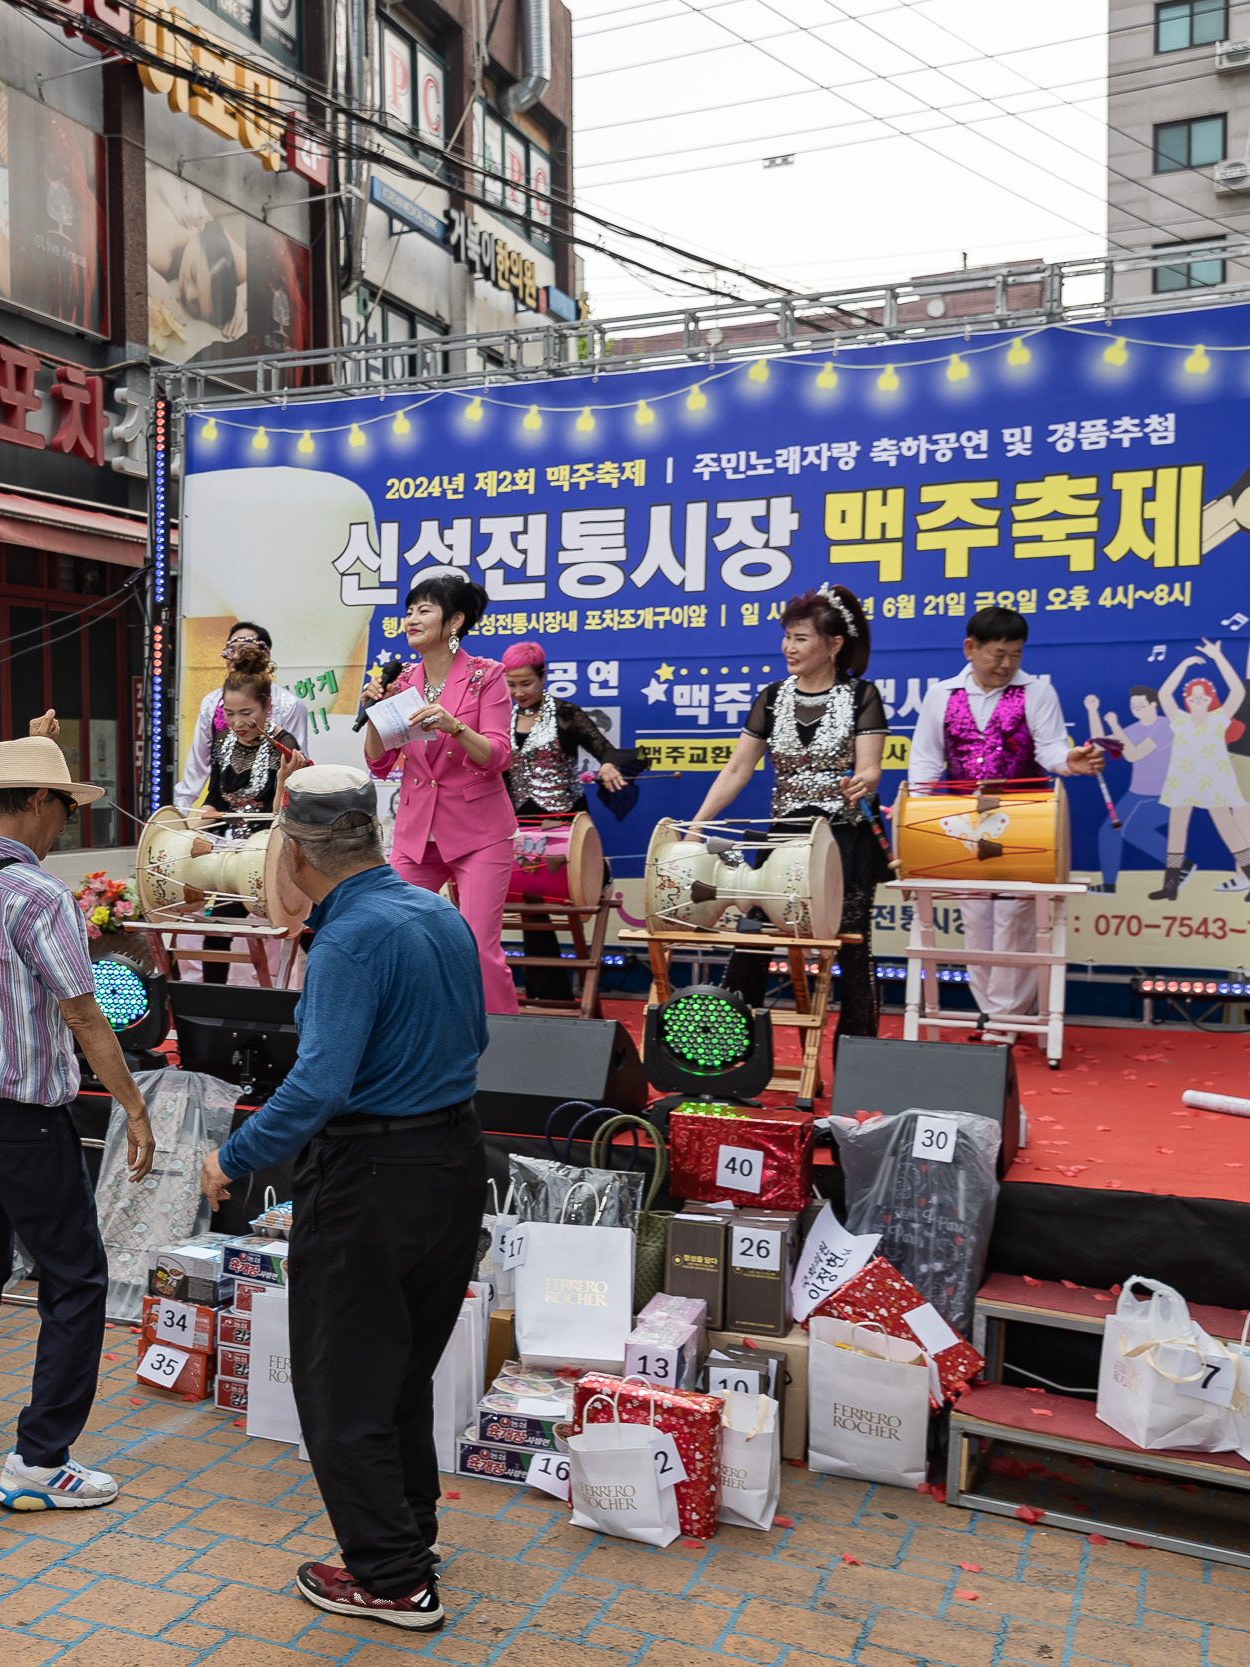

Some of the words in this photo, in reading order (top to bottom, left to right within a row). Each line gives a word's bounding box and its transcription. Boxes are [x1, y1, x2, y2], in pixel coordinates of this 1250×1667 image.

[450, 208, 538, 309] 거북이한의원
[692, 440, 861, 482] 주민노래자랑
[869, 429, 990, 467] 축하공연
[1001, 425, 1033, 458] 및
[1046, 413, 1177, 454] 경품추첨
[385, 473, 466, 500] 2024년
[474, 468, 536, 498] 제2회
[545, 459, 646, 492] 맥주축제
[332, 495, 800, 607] 신성전통시장
[822, 462, 1206, 584] 맥주축제
[882, 593, 916, 620] 6월
[923, 591, 966, 616] 21일
[1046, 586, 1090, 612] 오후
[1097, 581, 1192, 609] 4시~8시
[584, 604, 707, 631] 포차조개구이앞
[741, 603, 759, 627] 일
[921, 1128, 949, 1150] 30
[723, 1156, 754, 1178] 40
[508, 1236, 524, 1258] 17
[739, 1237, 771, 1259] 26
[228, 1257, 260, 1278] 육개장
[544, 1277, 609, 1294] FERRERO
[544, 1289, 608, 1308] ROCHER
[163, 1309, 188, 1332] 34
[150, 1353, 180, 1376] 35
[637, 1354, 670, 1379] 13
[1201, 1362, 1222, 1389] 7
[833, 1401, 902, 1428] FERRERO
[487, 1423, 527, 1444] 육개장
[832, 1414, 901, 1441] ROCHER
[467, 1454, 507, 1476] 육개장
[538, 1457, 570, 1482] 16
